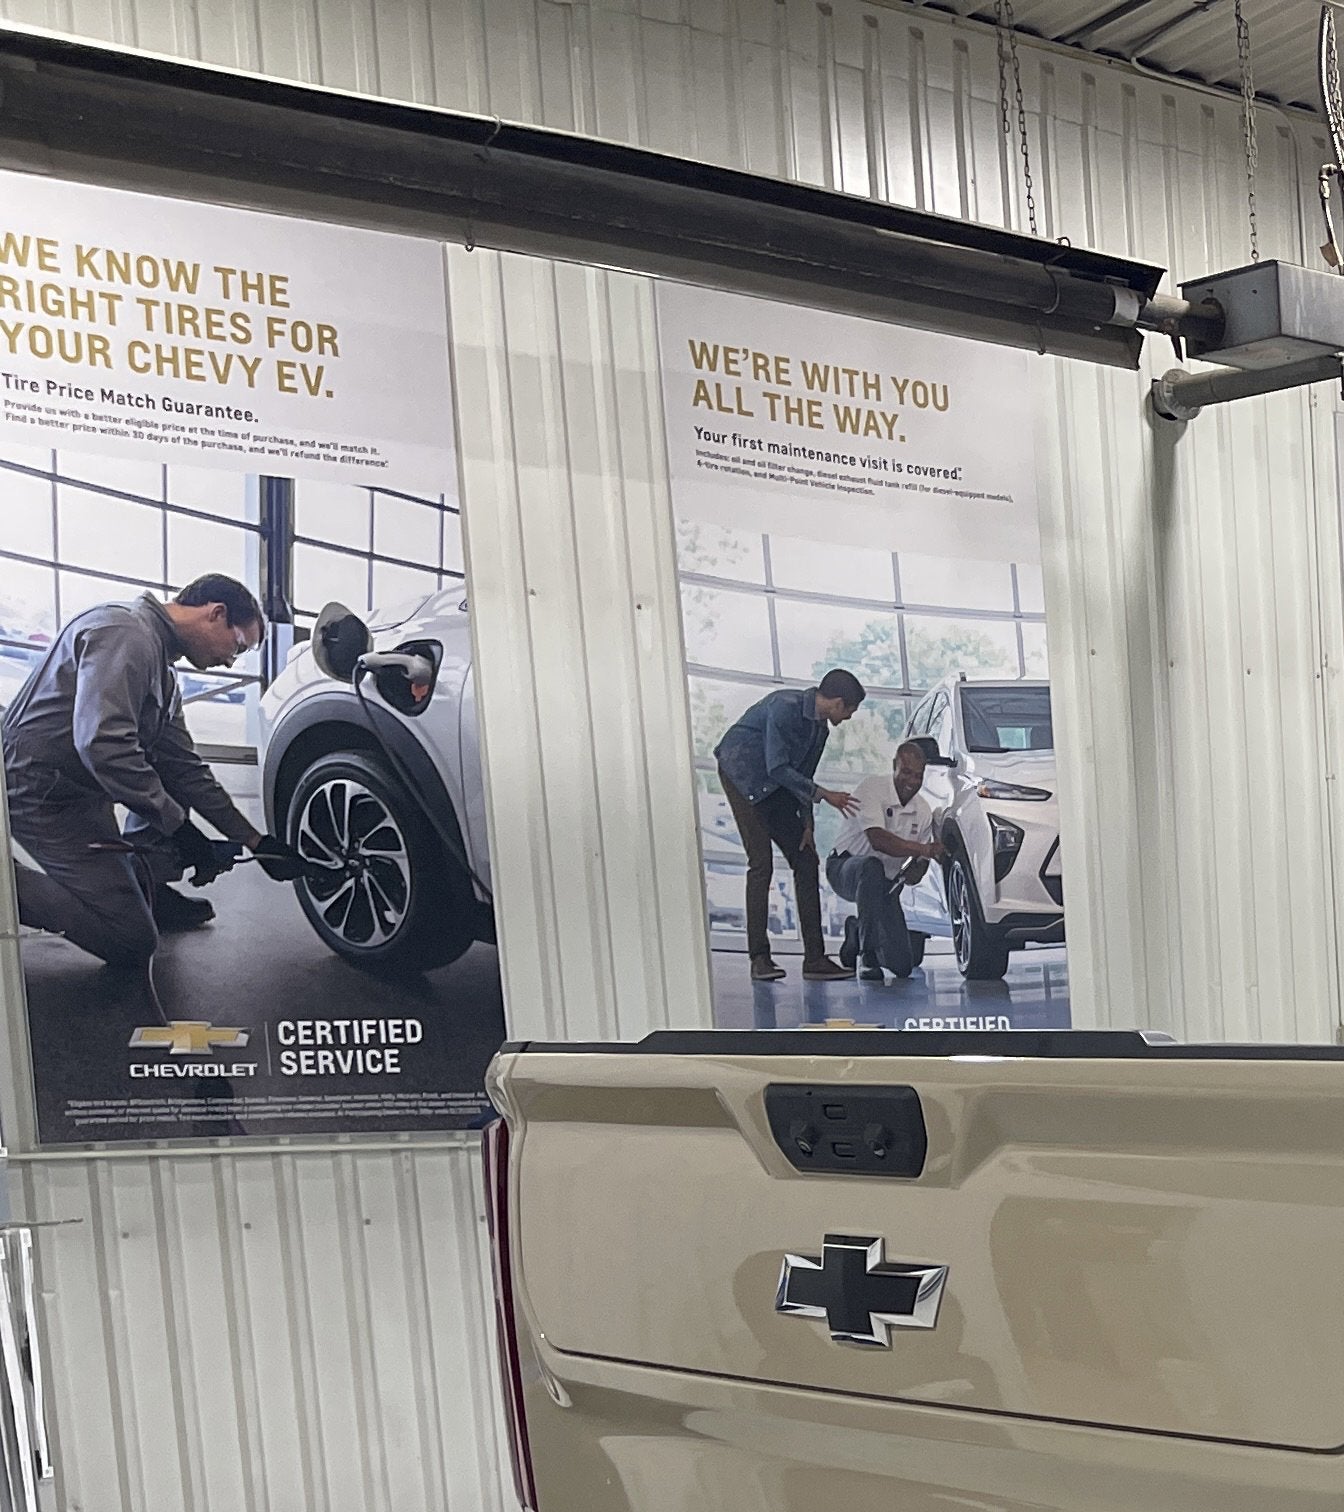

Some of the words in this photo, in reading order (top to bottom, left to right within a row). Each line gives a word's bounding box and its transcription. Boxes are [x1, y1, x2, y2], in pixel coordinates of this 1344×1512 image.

[0, 232, 61, 273] WE
[75, 244, 200, 295] KNOW
[213, 266, 290, 308] THE
[0, 274, 124, 326] RIGHT
[135, 297, 252, 345] TIRES
[267, 316, 340, 358] FOR
[0, 319, 113, 369] YOUR
[127, 340, 263, 389] CHEVY
[276, 360, 334, 399] EV.
[688, 339, 792, 387] WE'RE
[800, 360, 881, 402] WITH
[890, 376, 949, 412] YOU
[1, 372, 40, 393] Tire
[46, 379, 95, 401] Price
[100, 388, 156, 410] Match
[161, 396, 259, 423] Guarantee.
[692, 379, 754, 417] ALL
[762, 391, 824, 430] THE
[832, 403, 906, 442] WAY.
[693, 425, 728, 444] Your
[731, 432, 763, 451] first
[767, 442, 856, 467] maintenance
[859, 454, 888, 472] visit
[892, 458, 903, 473] is
[277, 1019, 423, 1045] CERTIFIED
[129, 1062, 258, 1078] CHEVROLET
[280, 1049, 401, 1076] SERVICE
